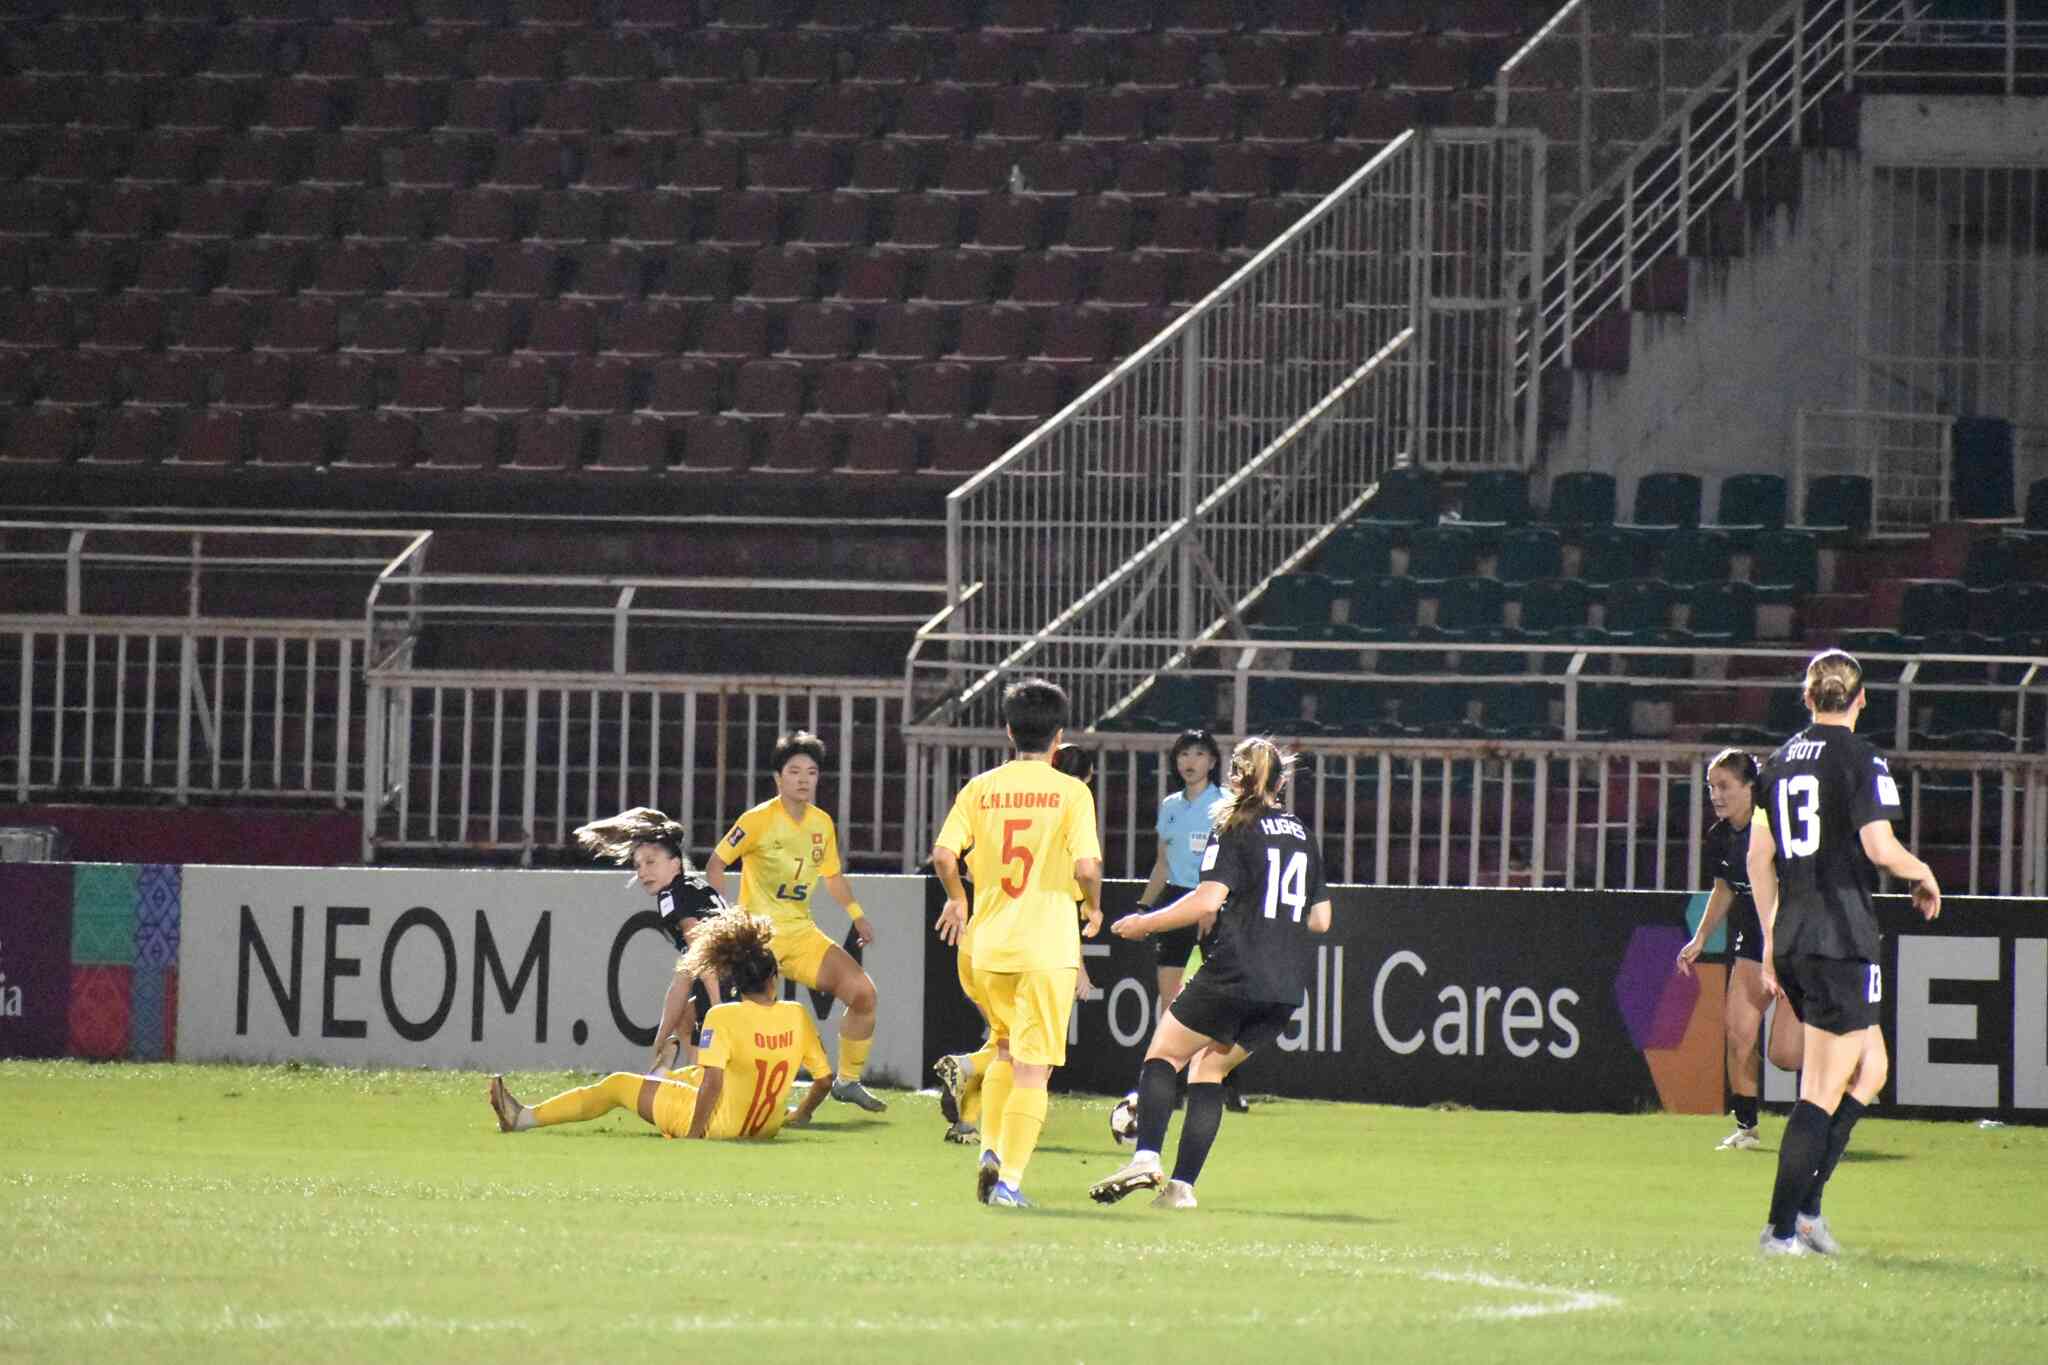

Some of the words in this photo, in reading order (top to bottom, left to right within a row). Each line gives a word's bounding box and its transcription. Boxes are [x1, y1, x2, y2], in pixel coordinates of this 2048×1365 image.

[1785, 740, 1827, 762] STOTT
[1778, 774, 1821, 859] 13
[775, 883, 808, 901] LS
[794, 856, 804, 881] 7
[1001, 819, 1034, 900] 5
[1264, 847, 1308, 923] 14
[1372, 949, 1581, 1060] Cares
[738, 1058, 789, 1137] 18
